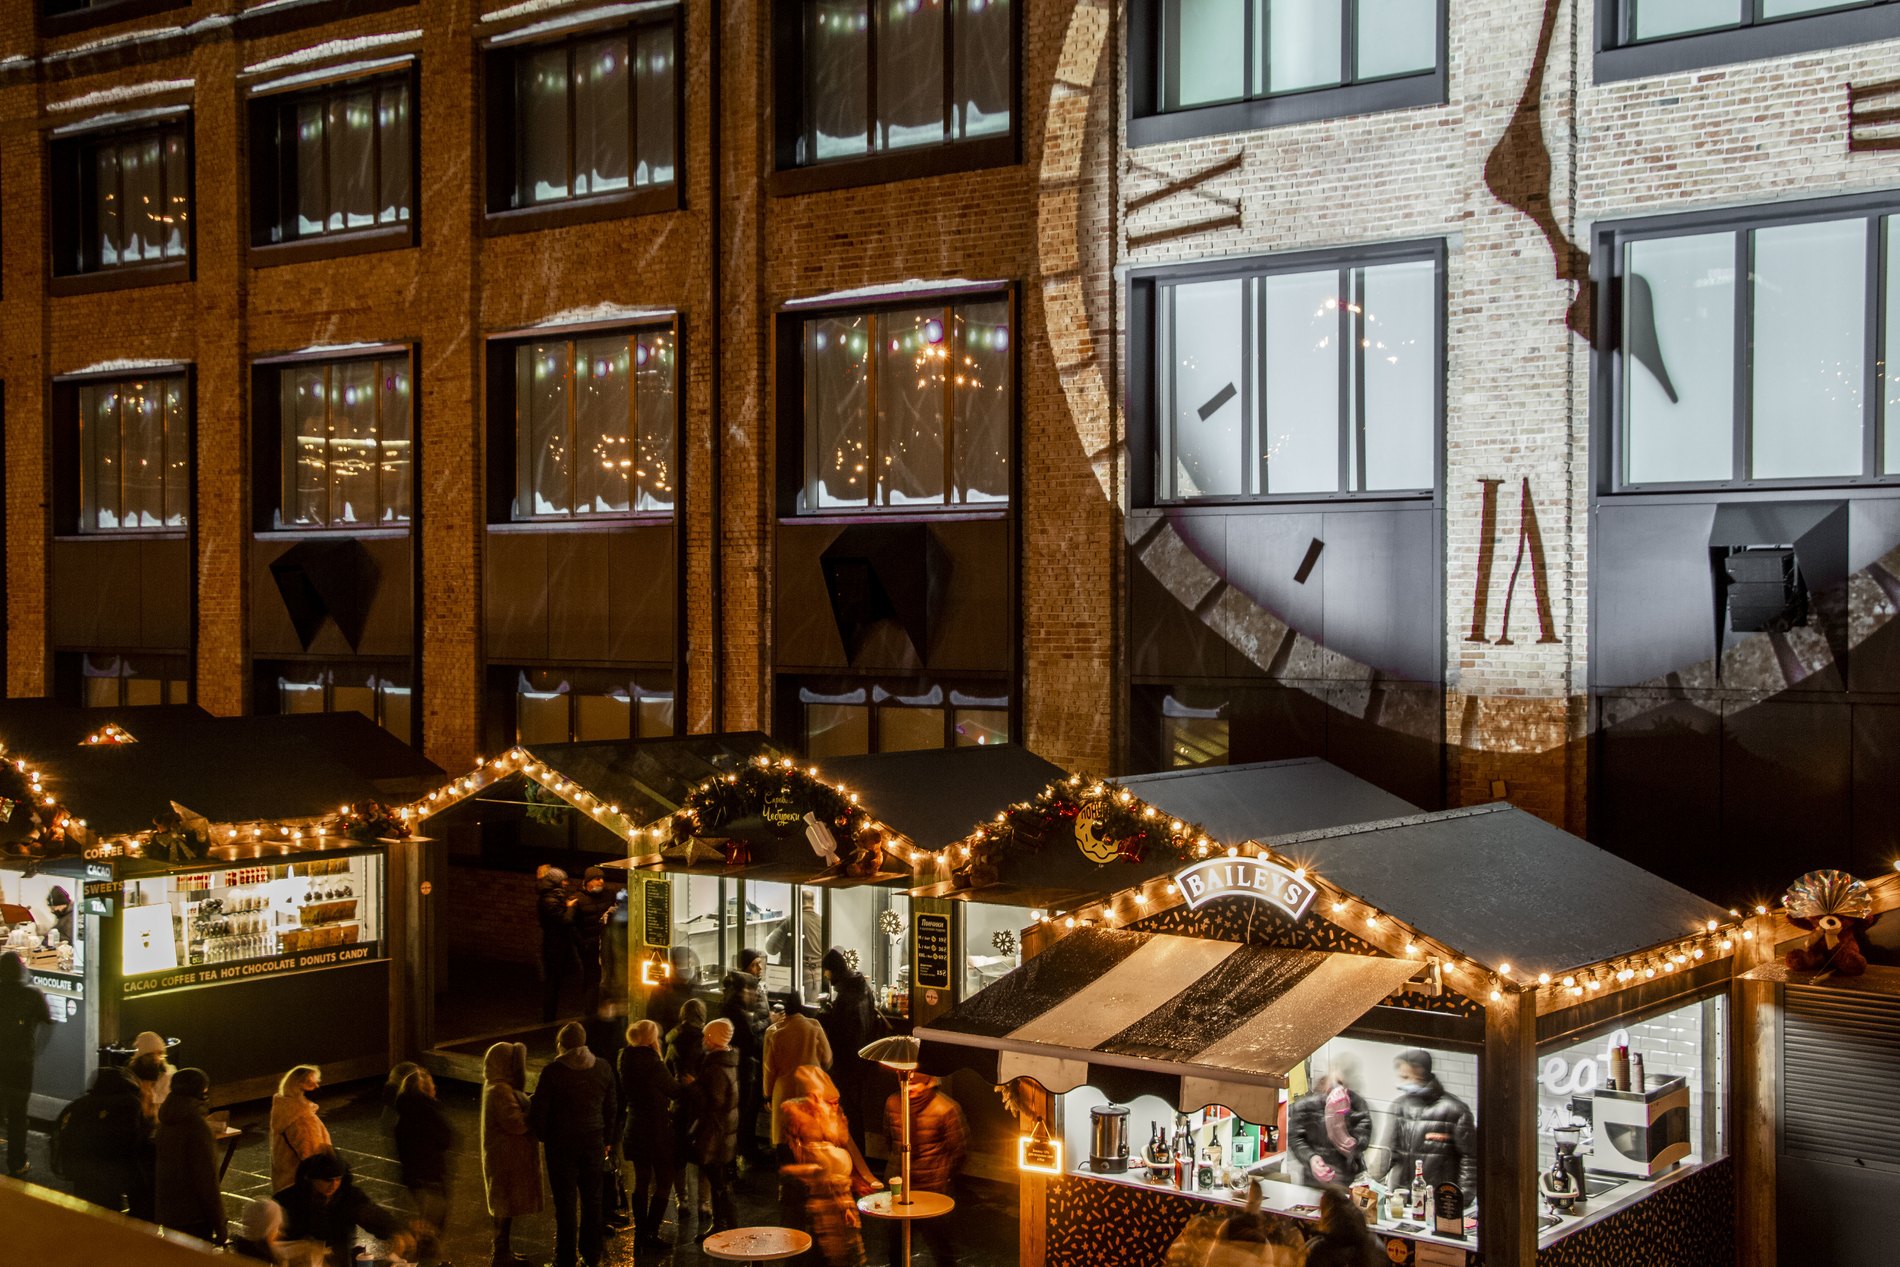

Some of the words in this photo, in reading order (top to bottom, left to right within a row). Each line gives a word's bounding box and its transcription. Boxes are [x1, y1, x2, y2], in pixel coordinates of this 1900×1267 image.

[84, 845, 124, 859] COFFEE
[86, 864, 111, 877] CACAO
[84, 881, 124, 895] SWEETS
[1186, 865, 1302, 905] BAILEYS
[91, 900, 107, 912] TEA
[123, 979, 158, 992] CACAO
[161, 973, 196, 986] COFFEE
[199, 970, 218, 981] TEA
[220, 966, 241, 978] HOT
[242, 959, 296, 975] CHOCOLATE
[300, 952, 337, 966] DONUTS
[339, 948, 369, 960] CANDY
[33, 976, 72, 991] CHOCOLATE
